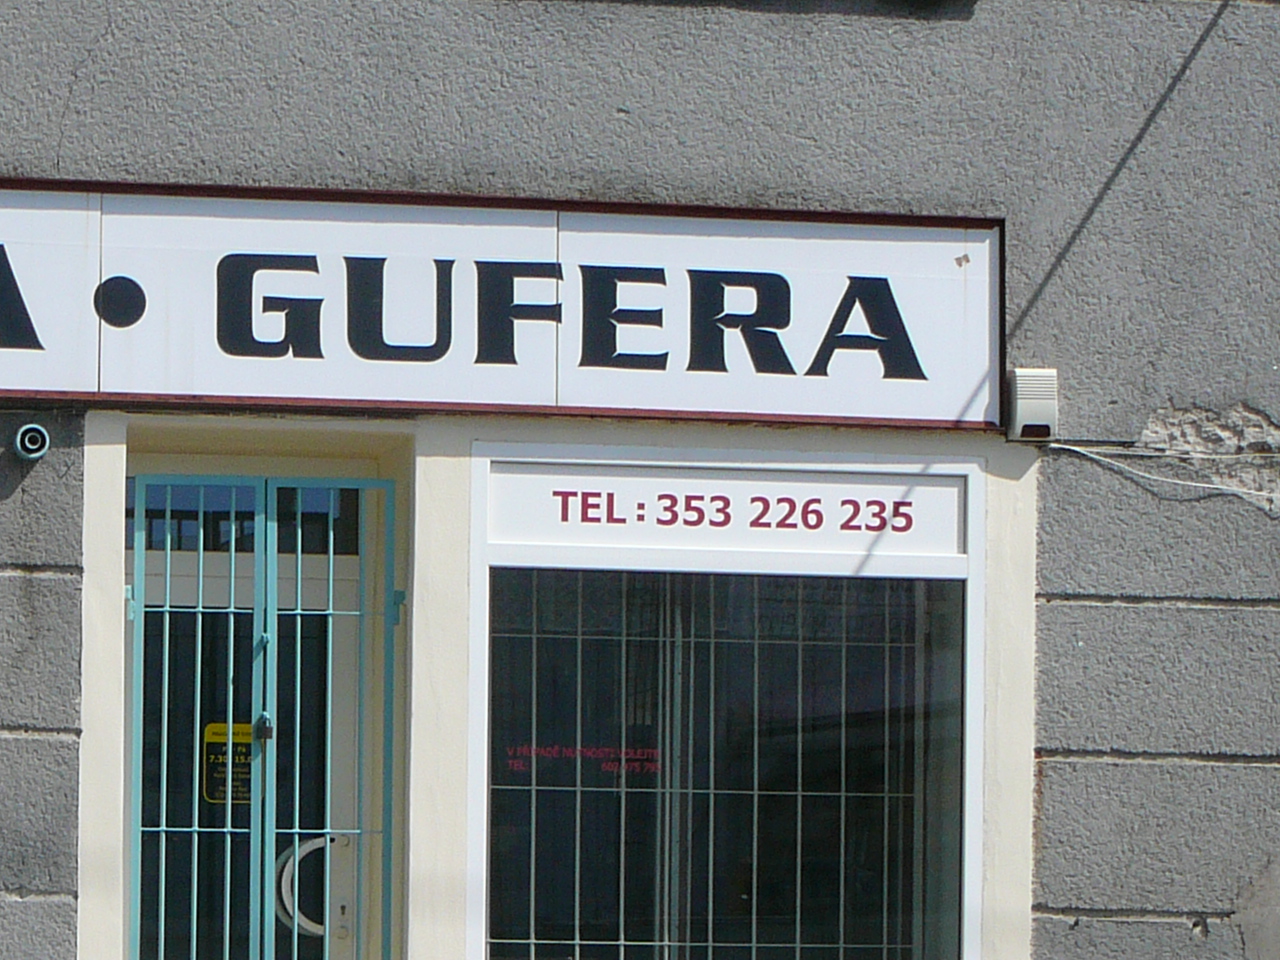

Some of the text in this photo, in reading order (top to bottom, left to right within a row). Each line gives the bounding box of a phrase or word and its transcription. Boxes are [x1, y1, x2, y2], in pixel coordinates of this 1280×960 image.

[216, 253, 928, 381] GUFERA
[749, 496, 824, 530] 226
[839, 499, 914, 533] 235
